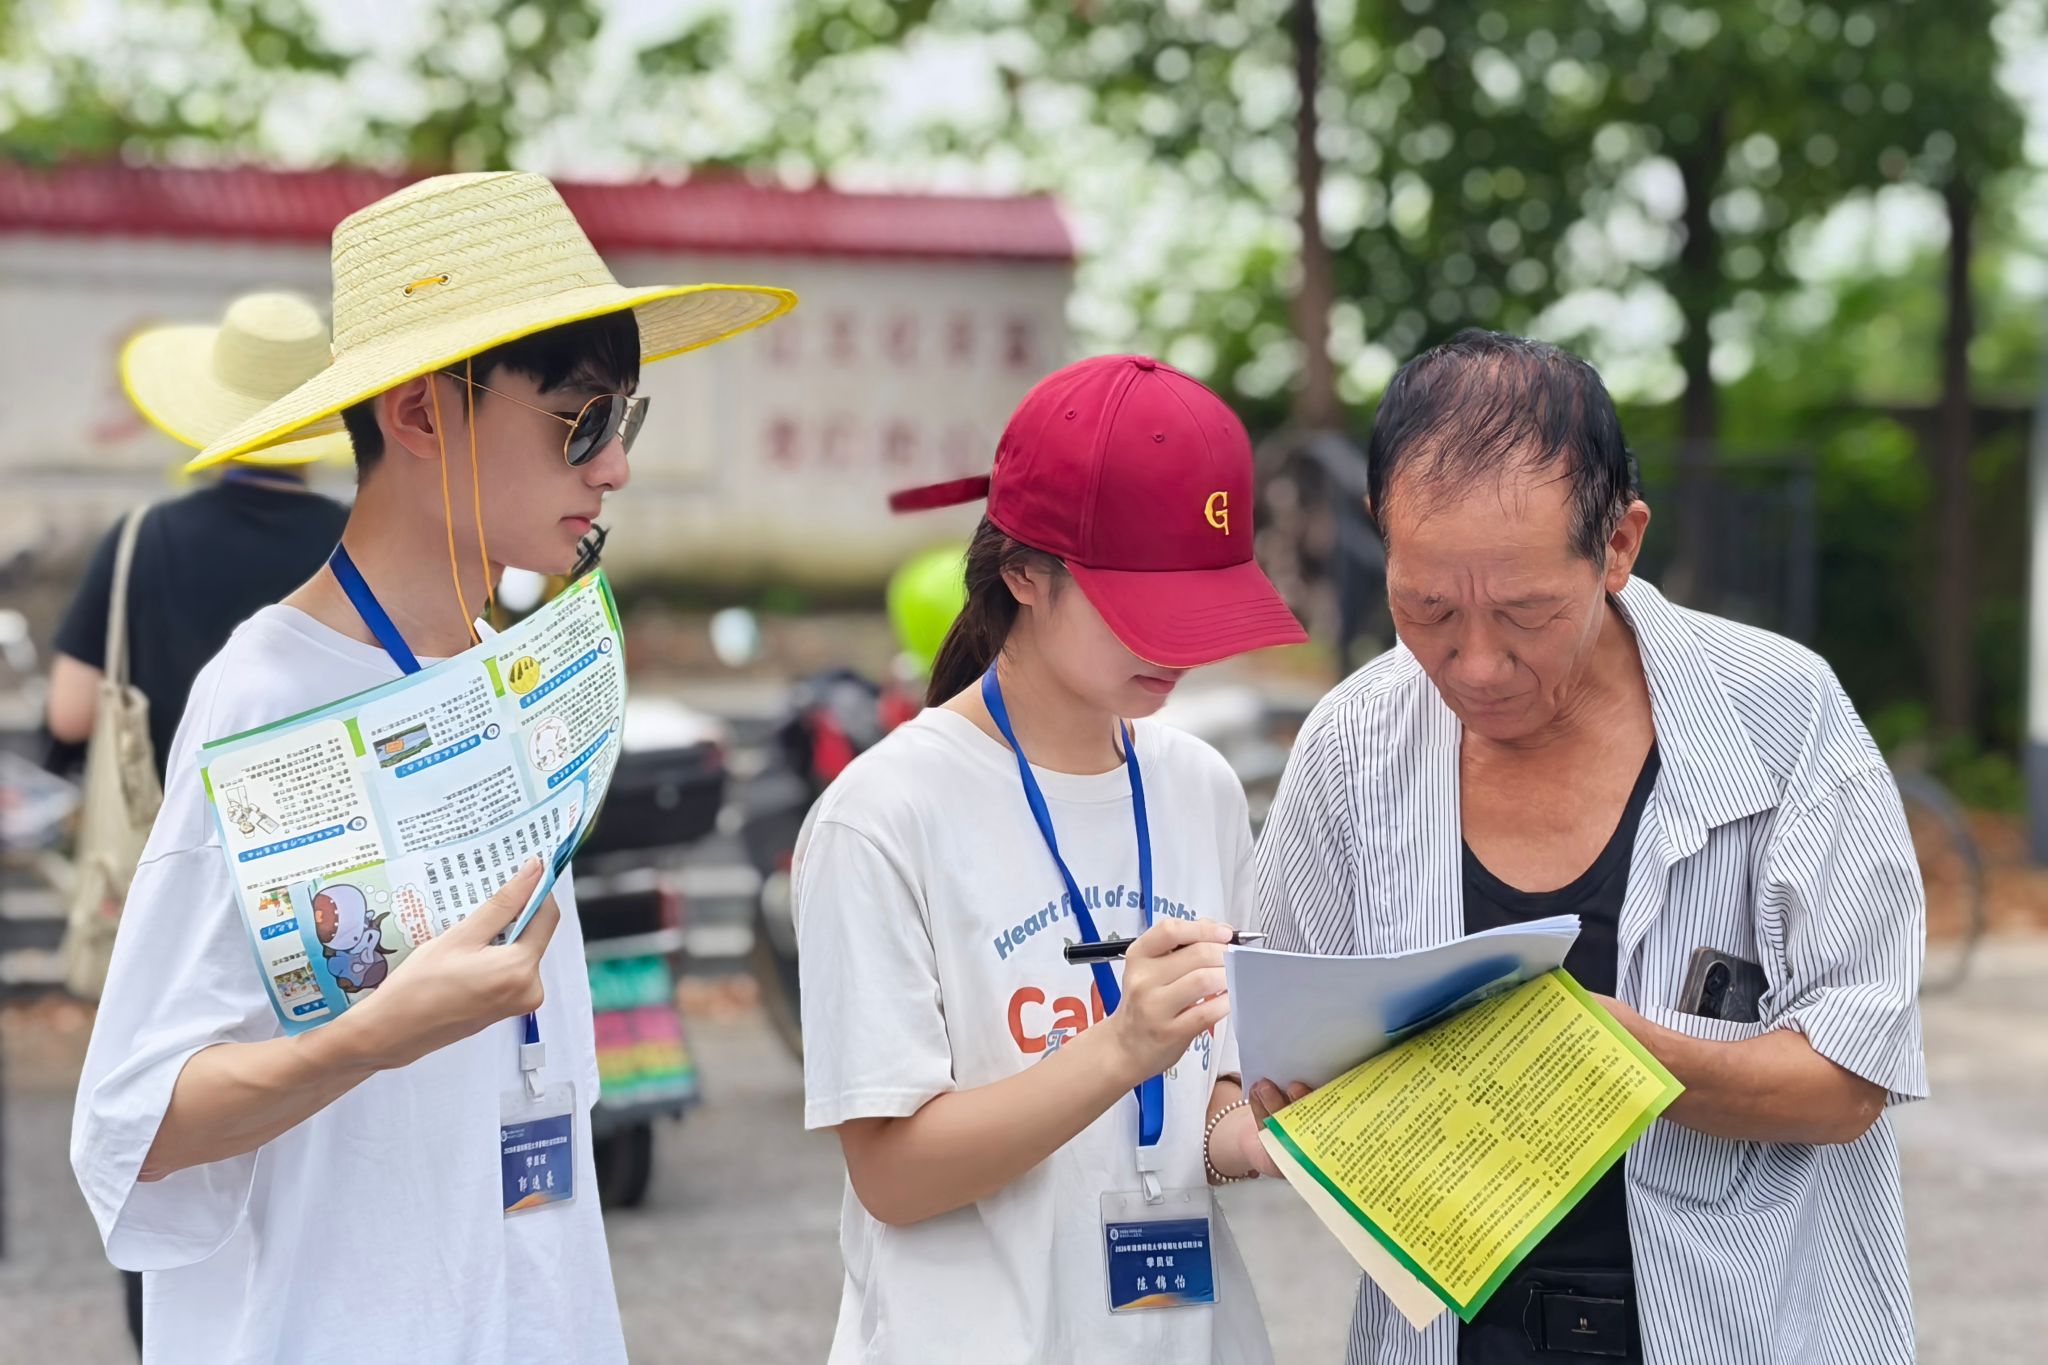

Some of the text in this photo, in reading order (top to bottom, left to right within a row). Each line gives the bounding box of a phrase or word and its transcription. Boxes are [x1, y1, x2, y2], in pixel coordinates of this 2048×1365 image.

[1204, 491, 1229, 536] G
[994, 901, 1060, 960] Heart
[1061, 885, 1102, 917] fll
[1105, 884, 1125, 909] of
